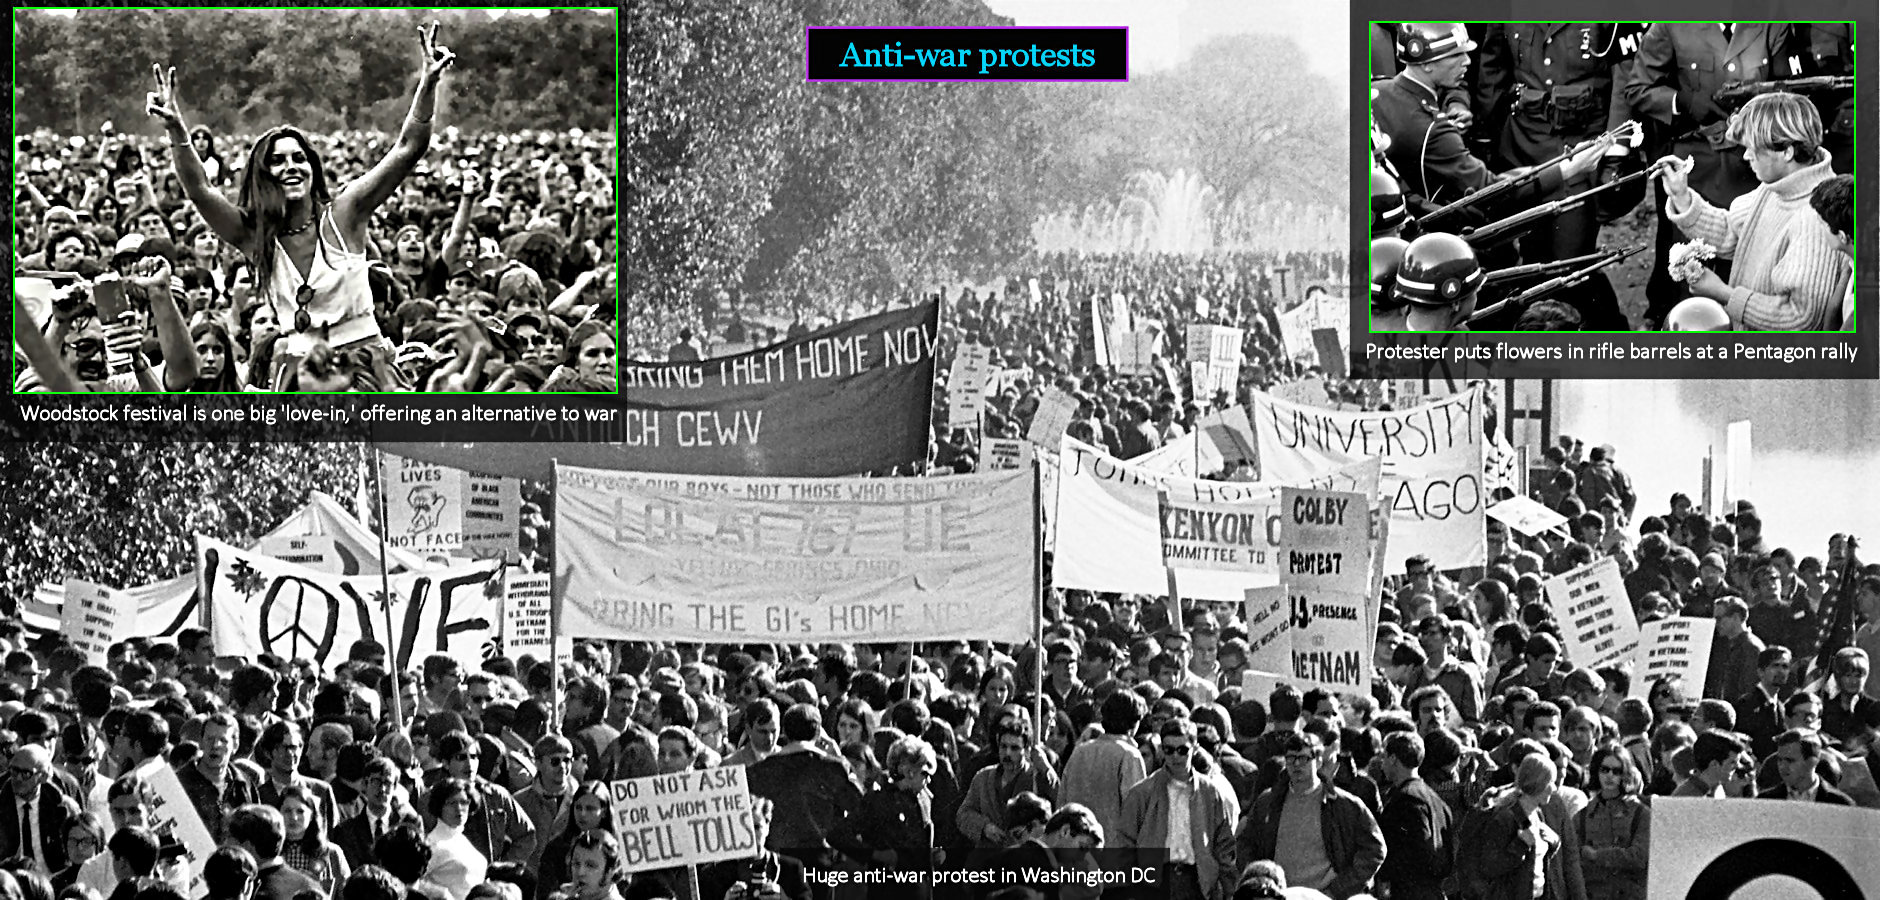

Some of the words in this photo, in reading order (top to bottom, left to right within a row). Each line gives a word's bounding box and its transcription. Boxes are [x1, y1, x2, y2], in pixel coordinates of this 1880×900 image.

[1619, 31, 1643, 56] M
[720, 349, 785, 387] THEM
[796, 334, 870, 380] HOME
[676, 409, 763, 447] CEWV
[1271, 392, 1476, 457] UNIVERSITY
[401, 469, 442, 483] LIVES
[686, 481, 729, 496] BOYS
[747, 484, 782, 500] NOT
[788, 483, 841, 499] THOSE
[849, 483, 887, 500] WHO
[893, 481, 936, 500] SEND
[1293, 496, 1349, 526] COLBY
[1159, 504, 1254, 546] KENYON
[390, 536, 416, 547] NOT
[1163, 544, 1238, 563] OMMITTEE
[1248, 550, 1265, 564] TO
[1289, 549, 1342, 575] PROTEST
[508, 590, 550, 600] WITHDRAWA
[526, 609, 549, 617] TROOP
[593, 600, 673, 632] BRING
[688, 604, 746, 632] THE
[828, 604, 905, 632] HOME
[1312, 604, 1358, 621] PRESENCE
[510, 638, 550, 647] VIETNAMES
[614, 781, 639, 802] DO
[653, 774, 691, 796] NOT
[699, 768, 738, 792] ASK
[618, 806, 650, 826] FOR
[656, 800, 708, 821] WHOM
[711, 794, 745, 813] THE
[622, 824, 683, 866] BELL
[687, 812, 755, 854] TOLLS
